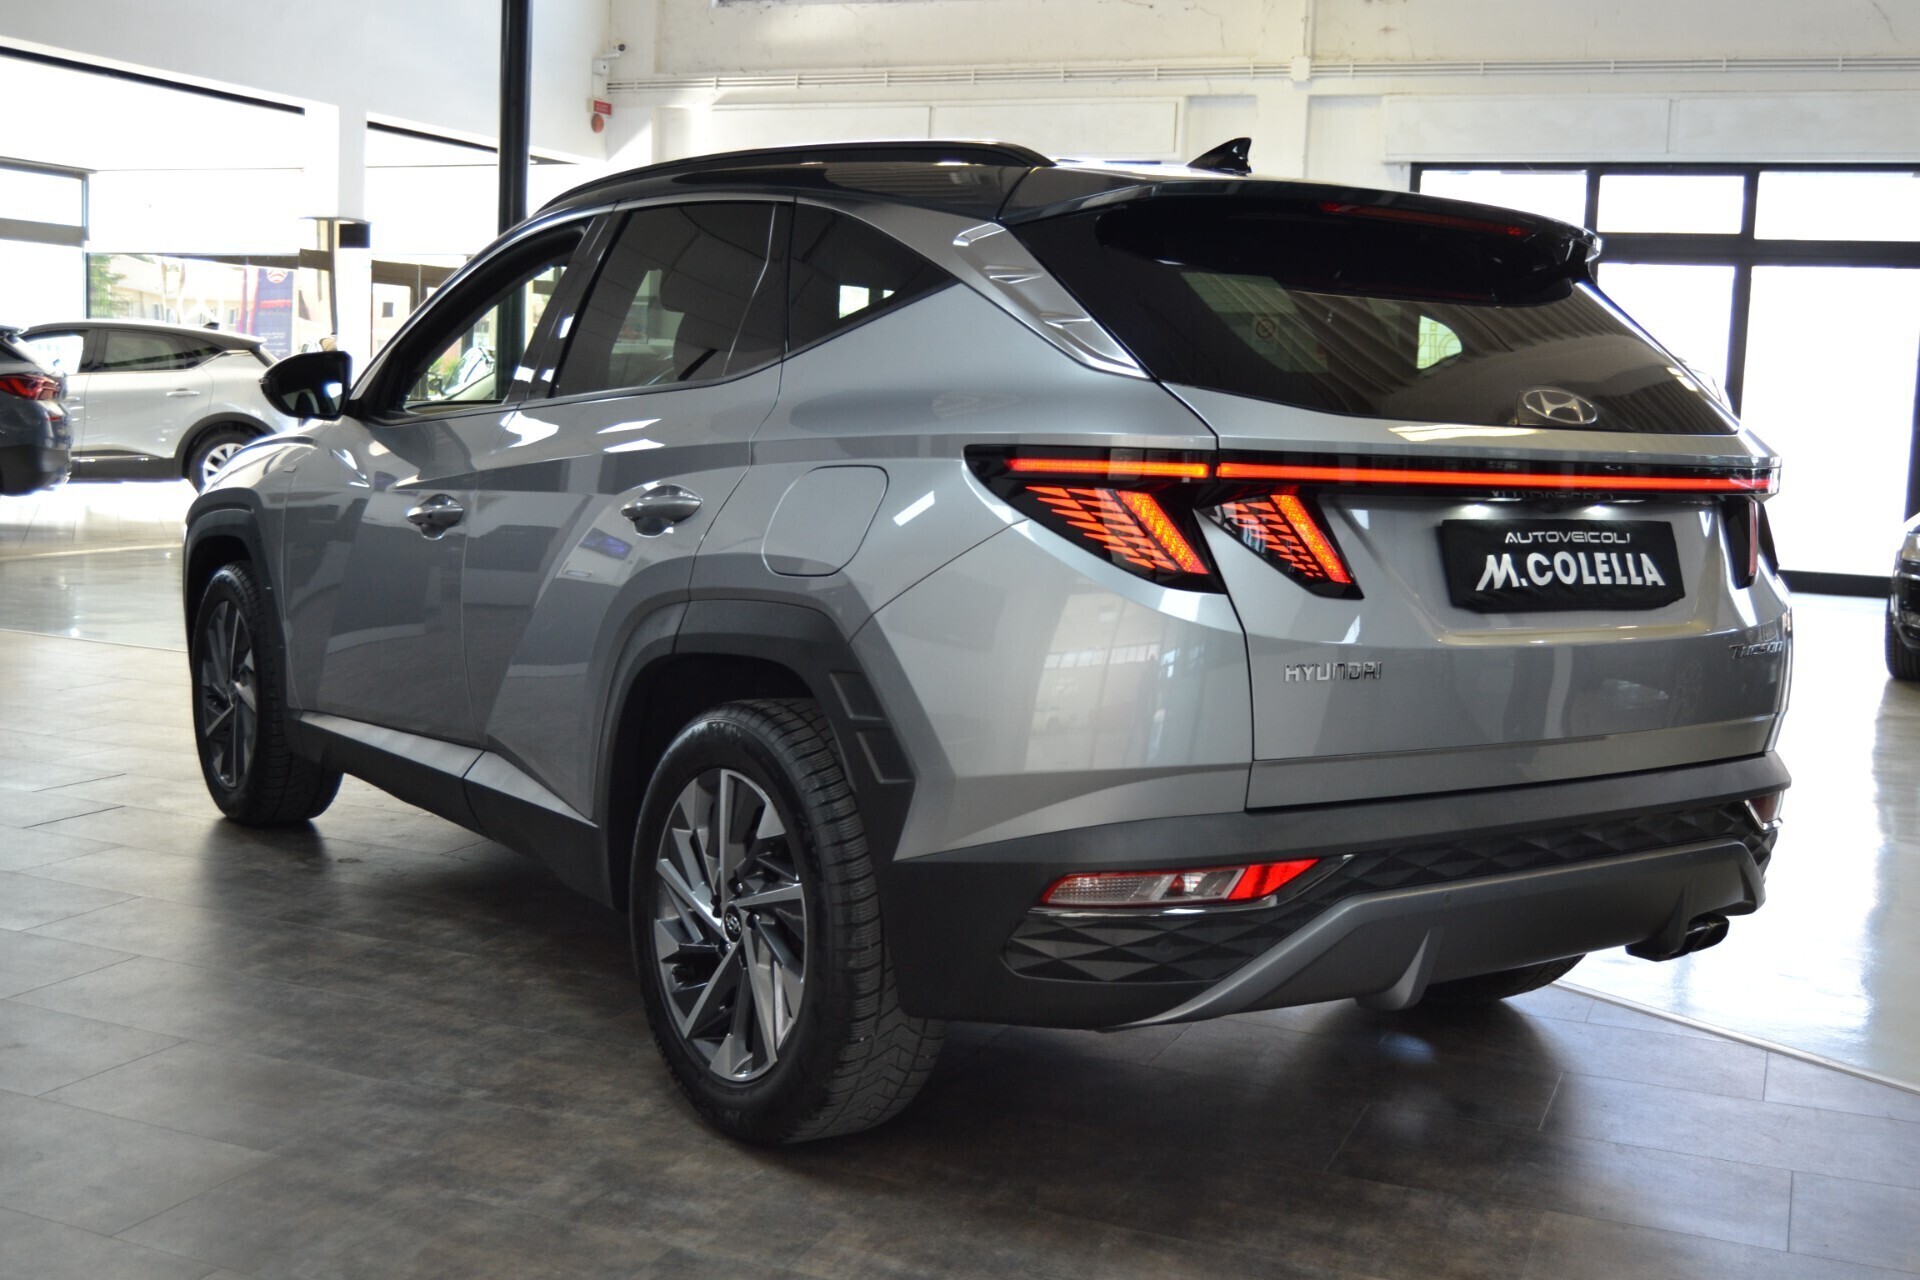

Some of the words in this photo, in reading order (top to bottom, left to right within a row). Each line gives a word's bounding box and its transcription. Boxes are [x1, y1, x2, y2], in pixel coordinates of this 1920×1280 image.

[1504, 531, 1631, 544] AUTOVEICOLI
[1475, 551, 1665, 591] M.COLELLA
[1284, 661, 1382, 682] HYUNDAI
